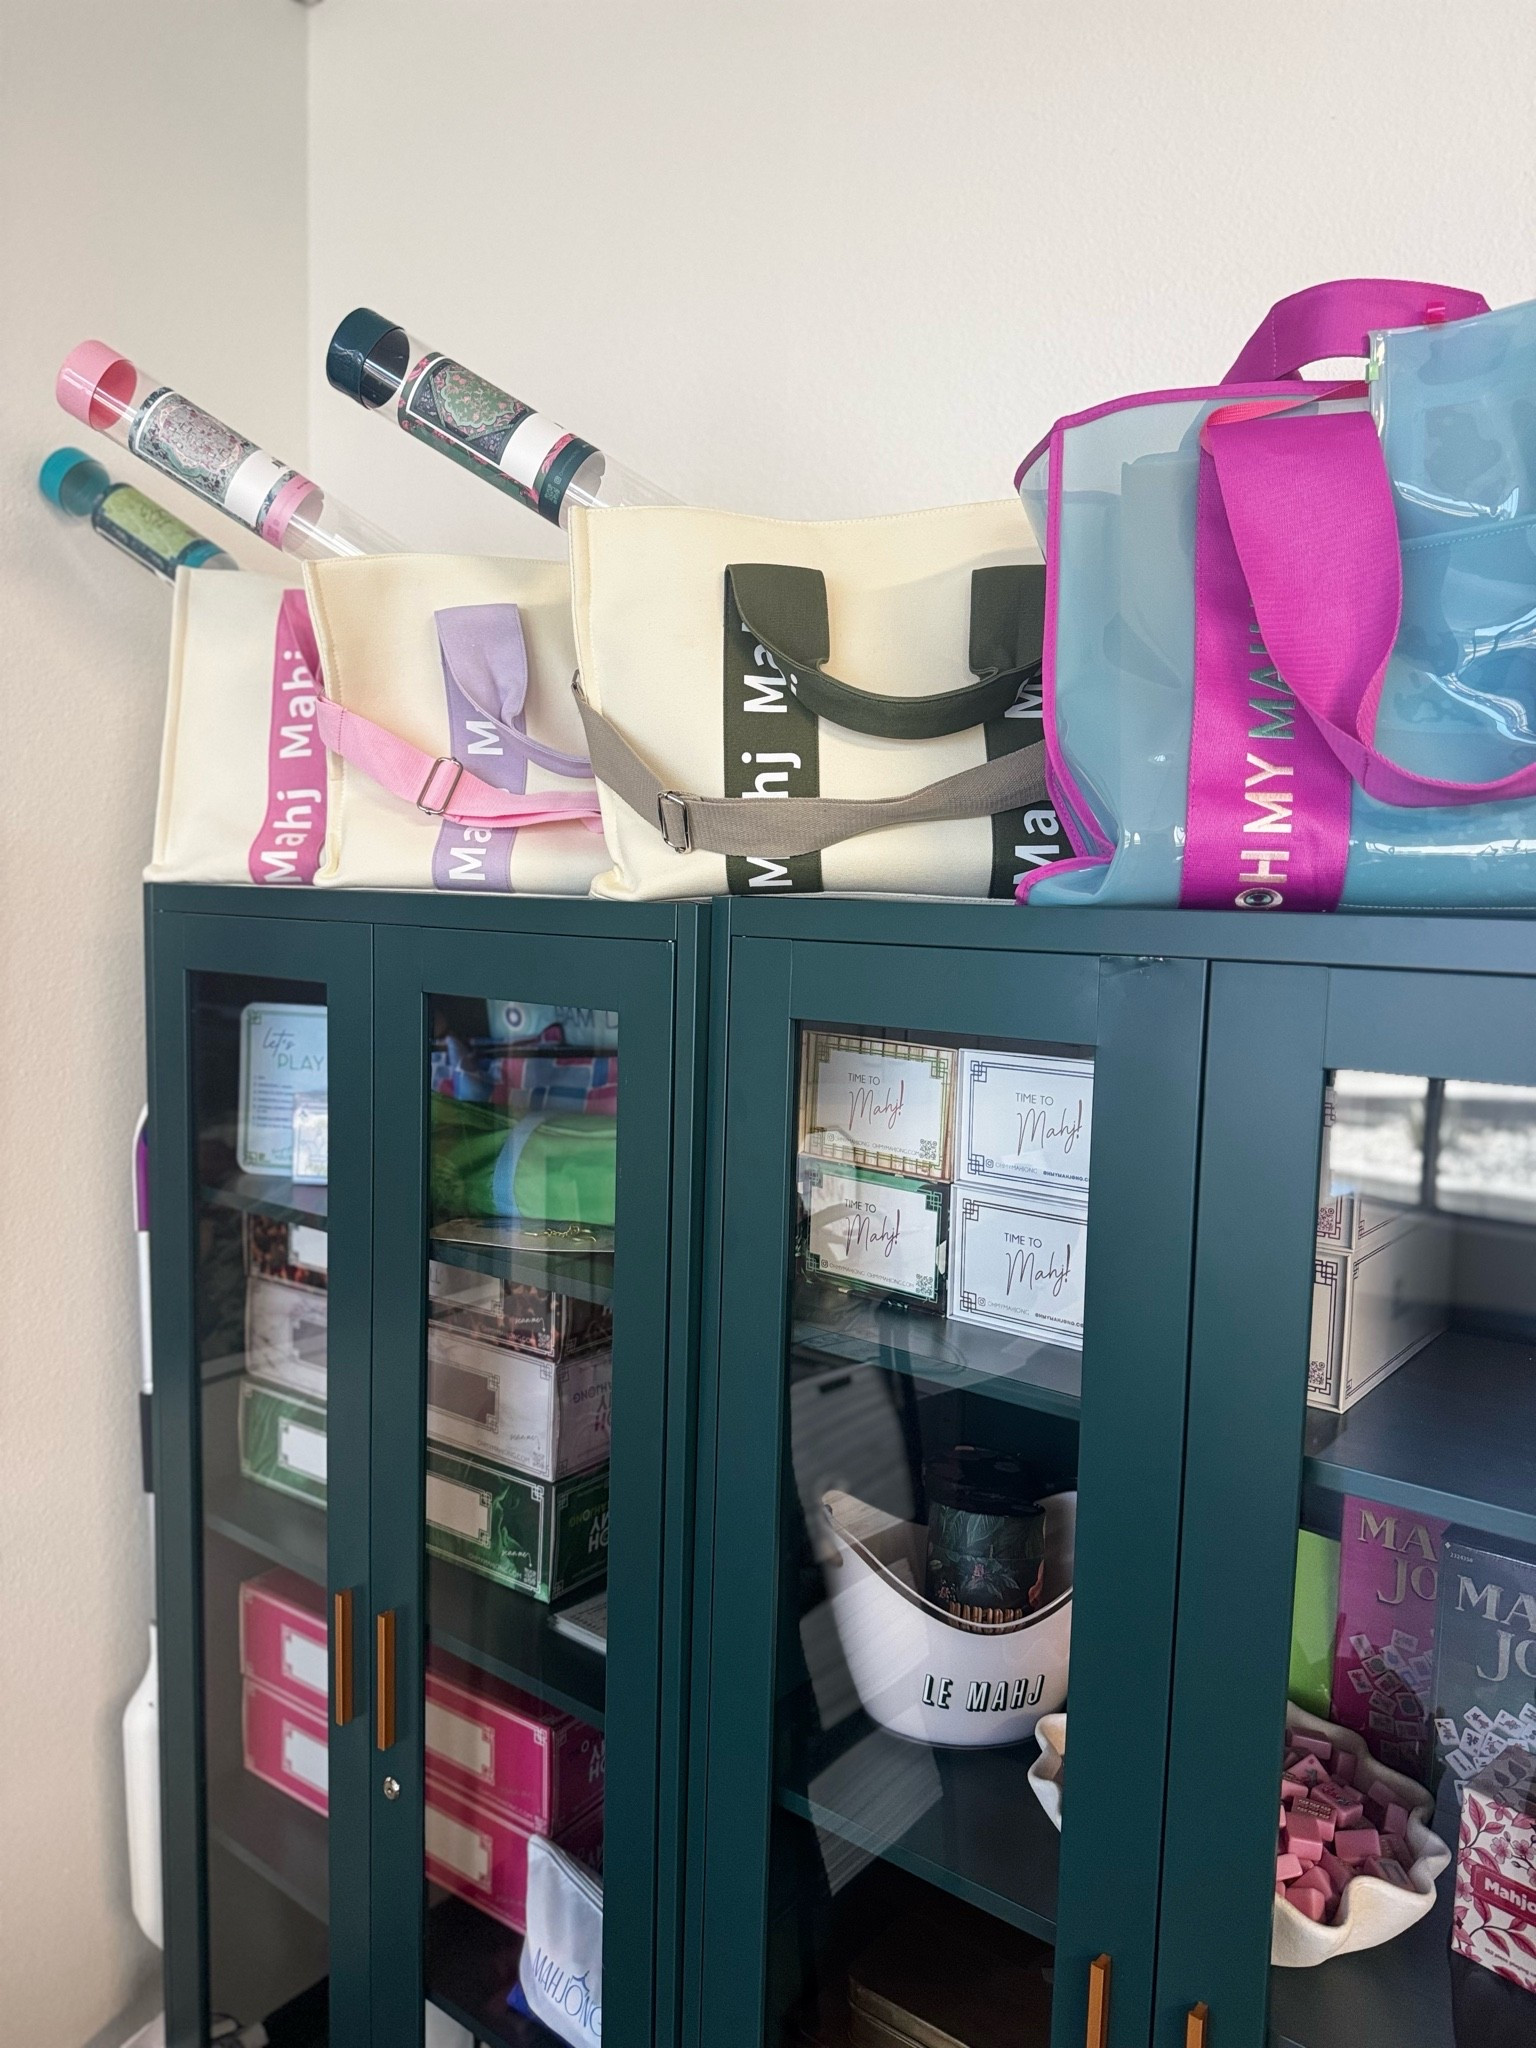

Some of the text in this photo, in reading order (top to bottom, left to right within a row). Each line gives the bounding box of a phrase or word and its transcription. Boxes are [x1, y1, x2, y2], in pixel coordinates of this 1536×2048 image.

[1243, 752, 1294, 833] MY
[261, 789, 322, 882] Mahj
[742, 752, 801, 887] Mhj
[277, 1053, 324, 1072] PLAY
[848, 1073, 880, 1086] TIME TO
[849, 1080, 904, 1131] Mahj!
[1015, 1092, 1054, 1106] TIME TO
[1017, 1099, 1083, 1156] Mahj!
[845, 1198, 877, 1213] TIME TO
[846, 1209, 900, 1257] Mahj!
[1004, 1232, 1042, 1248] TIME TO
[1006, 1243, 1071, 1297] Mahj!
[922, 1674, 1045, 1712] LE MAHJ
